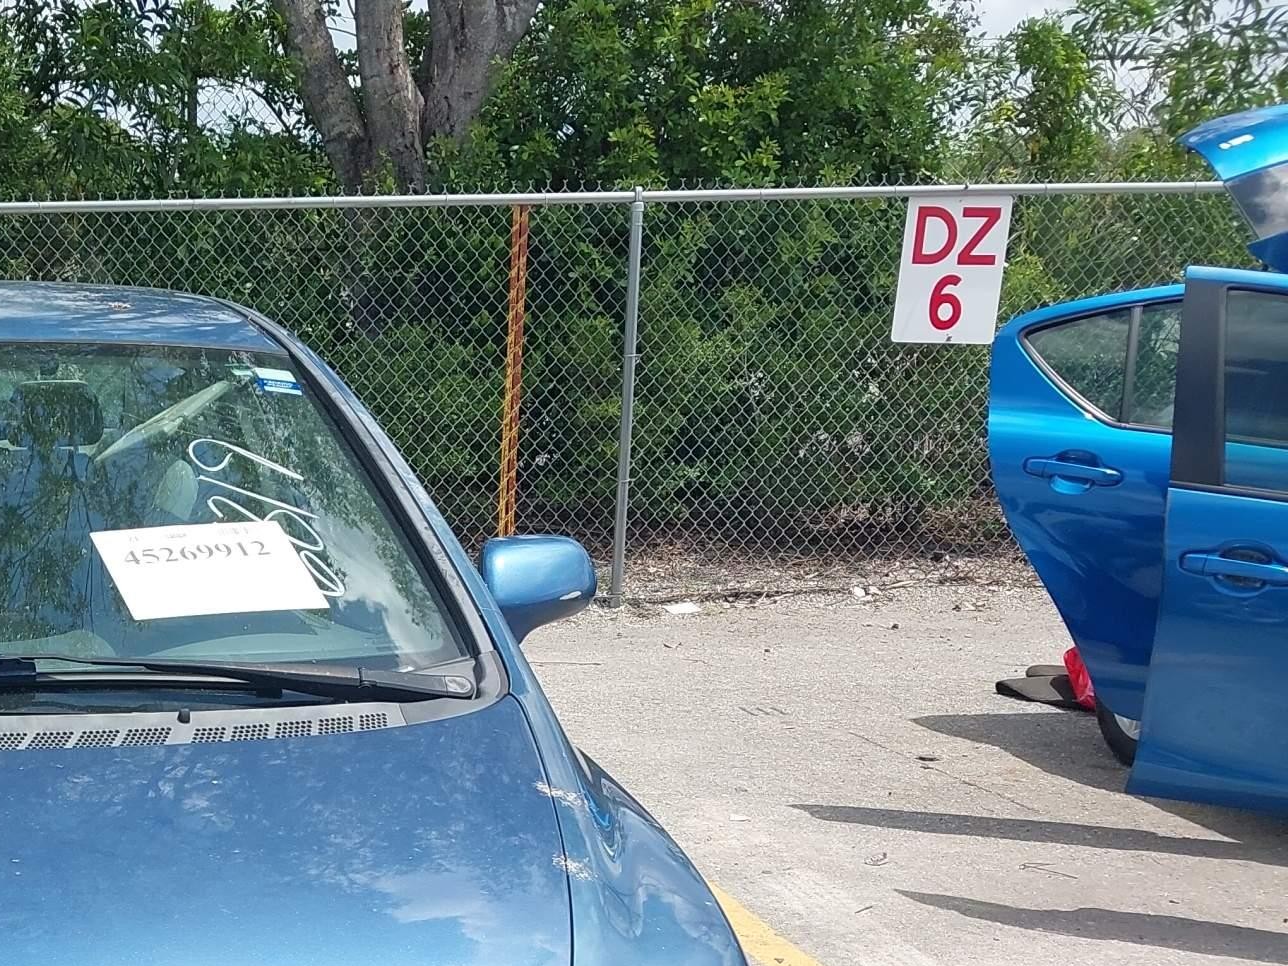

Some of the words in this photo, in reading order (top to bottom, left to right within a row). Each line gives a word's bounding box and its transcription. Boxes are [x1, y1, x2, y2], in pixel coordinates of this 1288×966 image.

[912, 207, 1000, 265] DZ
[930, 275, 962, 330] 6
[124, 541, 272, 565] 45269912
